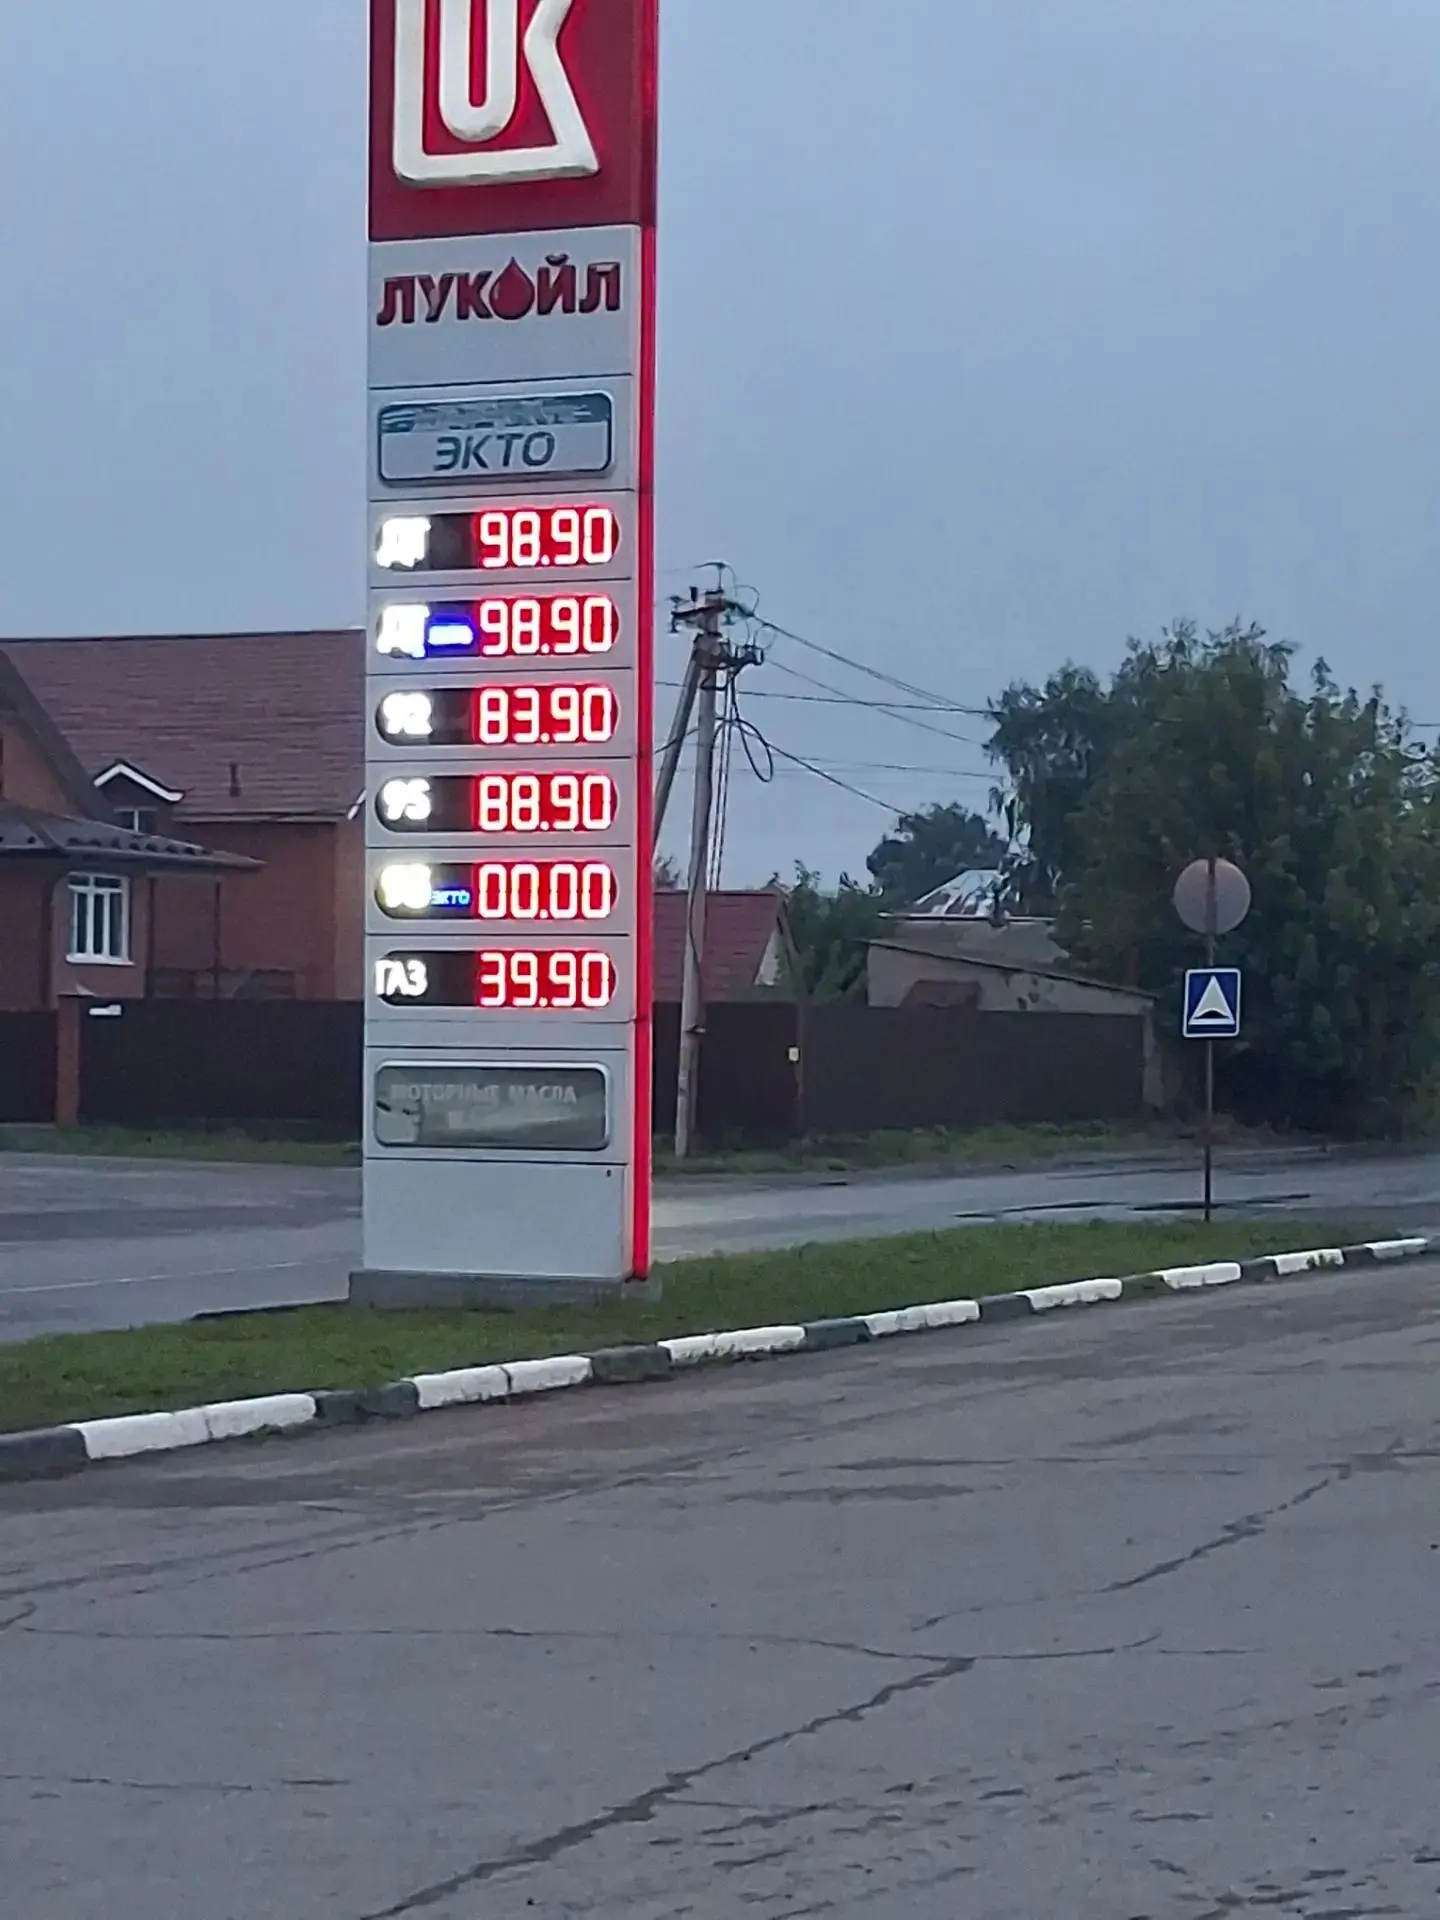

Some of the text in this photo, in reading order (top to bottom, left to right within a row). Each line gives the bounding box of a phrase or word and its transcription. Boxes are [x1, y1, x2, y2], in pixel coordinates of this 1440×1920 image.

[376, 254, 620, 326] ЛУКОЙЛ
[433, 431, 556, 471] ЭКТО
[479, 508, 612, 568] 98.90
[479, 596, 612, 655] 98.90
[479, 687, 611, 744] 83.90
[382, 775, 611, 831] 95 88.90
[478, 863, 610, 919] 00.00
[375, 952, 609, 1007] ГАЗ 39.90
